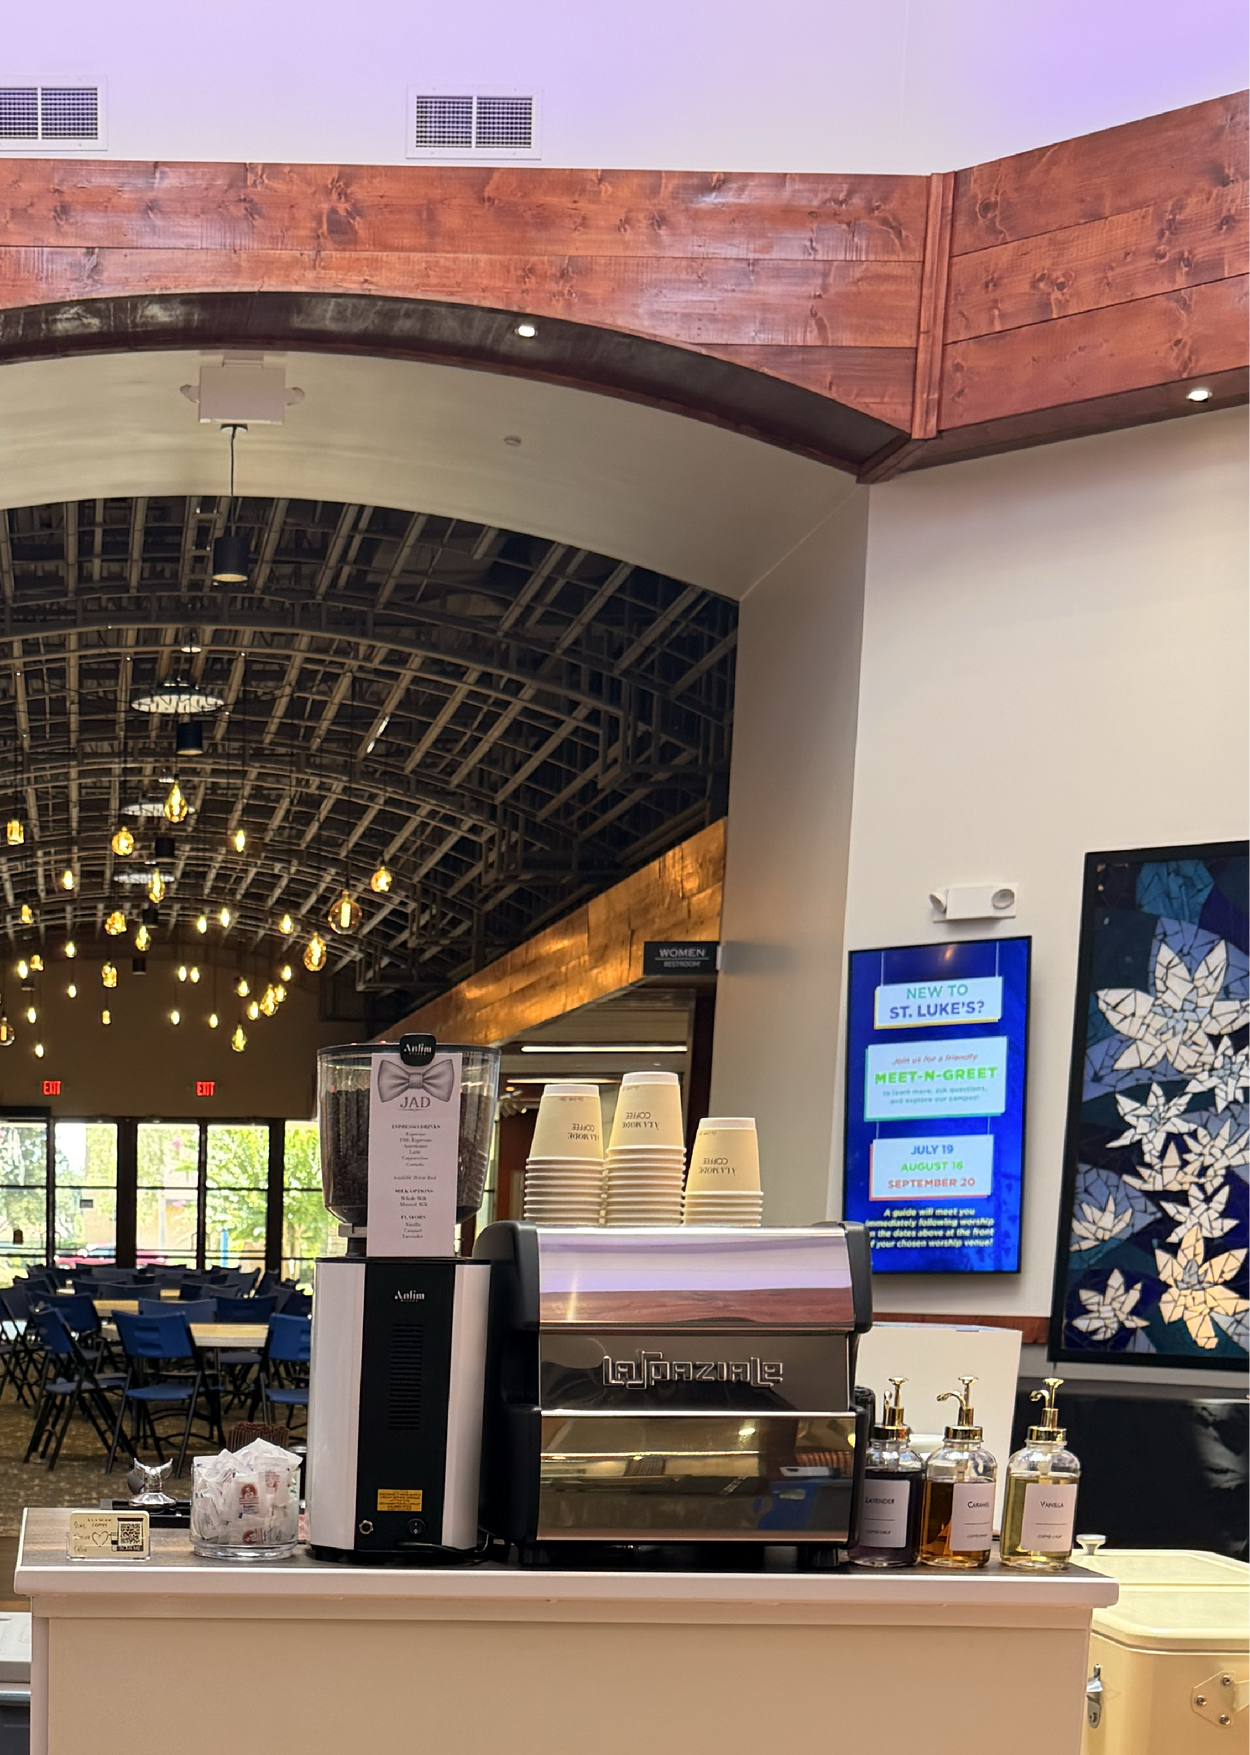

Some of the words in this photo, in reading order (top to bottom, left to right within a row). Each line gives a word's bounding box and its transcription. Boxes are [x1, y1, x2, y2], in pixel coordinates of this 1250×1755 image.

[659, 948, 706, 957] WOMEN
[906, 986, 943, 999] NEW
[948, 984, 969, 997] TO
[889, 1006, 913, 1020] ST.
[917, 1001, 985, 1018] LUKE'S?
[892, 1057, 910, 1066] Join
[923, 1055, 937, 1063] for
[945, 1053, 978, 1062] friendly
[875, 1066, 998, 1085] MEET-N-GREET
[42, 1080, 61, 1096] EXIT
[196, 1081, 215, 1096] EXIT
[400, 1096, 431, 1108] JAD
[911, 1145, 939, 1155] JULY
[942, 1144, 954, 1154] 19
[900, 1161, 948, 1172] AUGUST
[888, 1178, 958, 1189] SEPTEMBER
[961, 1177, 975, 1187] 20
[883, 1208, 890, 1217] A
[892, 1208, 916, 1218] guide
[918, 1207, 933, 1216] will
[935, 1207, 958, 1216] meet
[959, 1208, 975, 1217] you
[865, 1218, 916, 1228] immediately
[918, 1217, 958, 1228] following
[959, 1217, 994, 1227] worship
[877, 1229, 891, 1237] the
[893, 1229, 916, 1238] dates
[917, 1228, 943, 1237] above
[945, 1228, 955, 1237] at
[956, 1228, 970, 1236] the
[972, 1227, 994, 1236] front
[876, 1240, 895, 1249] your
[897, 1239, 927, 1248] chosen
[928, 1238, 962, 1248] worship
[964, 1238, 994, 1247] venue!
